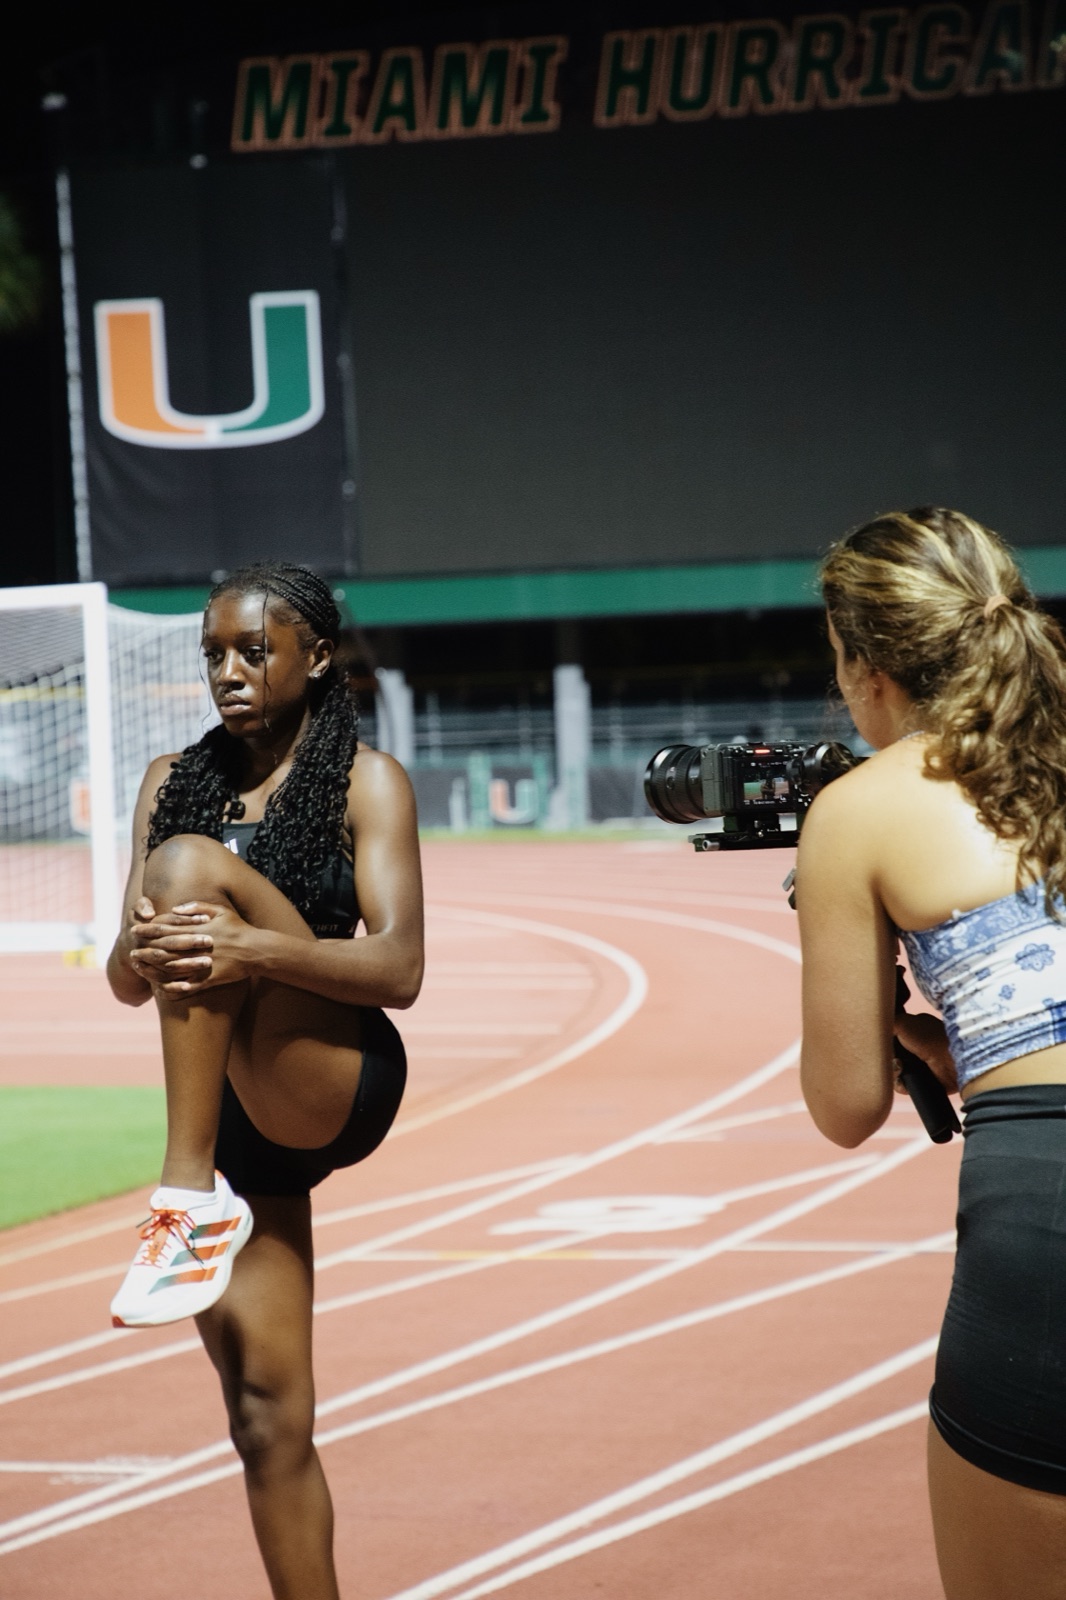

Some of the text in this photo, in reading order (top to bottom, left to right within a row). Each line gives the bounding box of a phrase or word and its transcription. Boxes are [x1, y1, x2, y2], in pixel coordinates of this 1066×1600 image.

[231, 35, 569, 152] MIAMI
[94, 290, 325, 449] U
[488, 778, 540, 824] U
